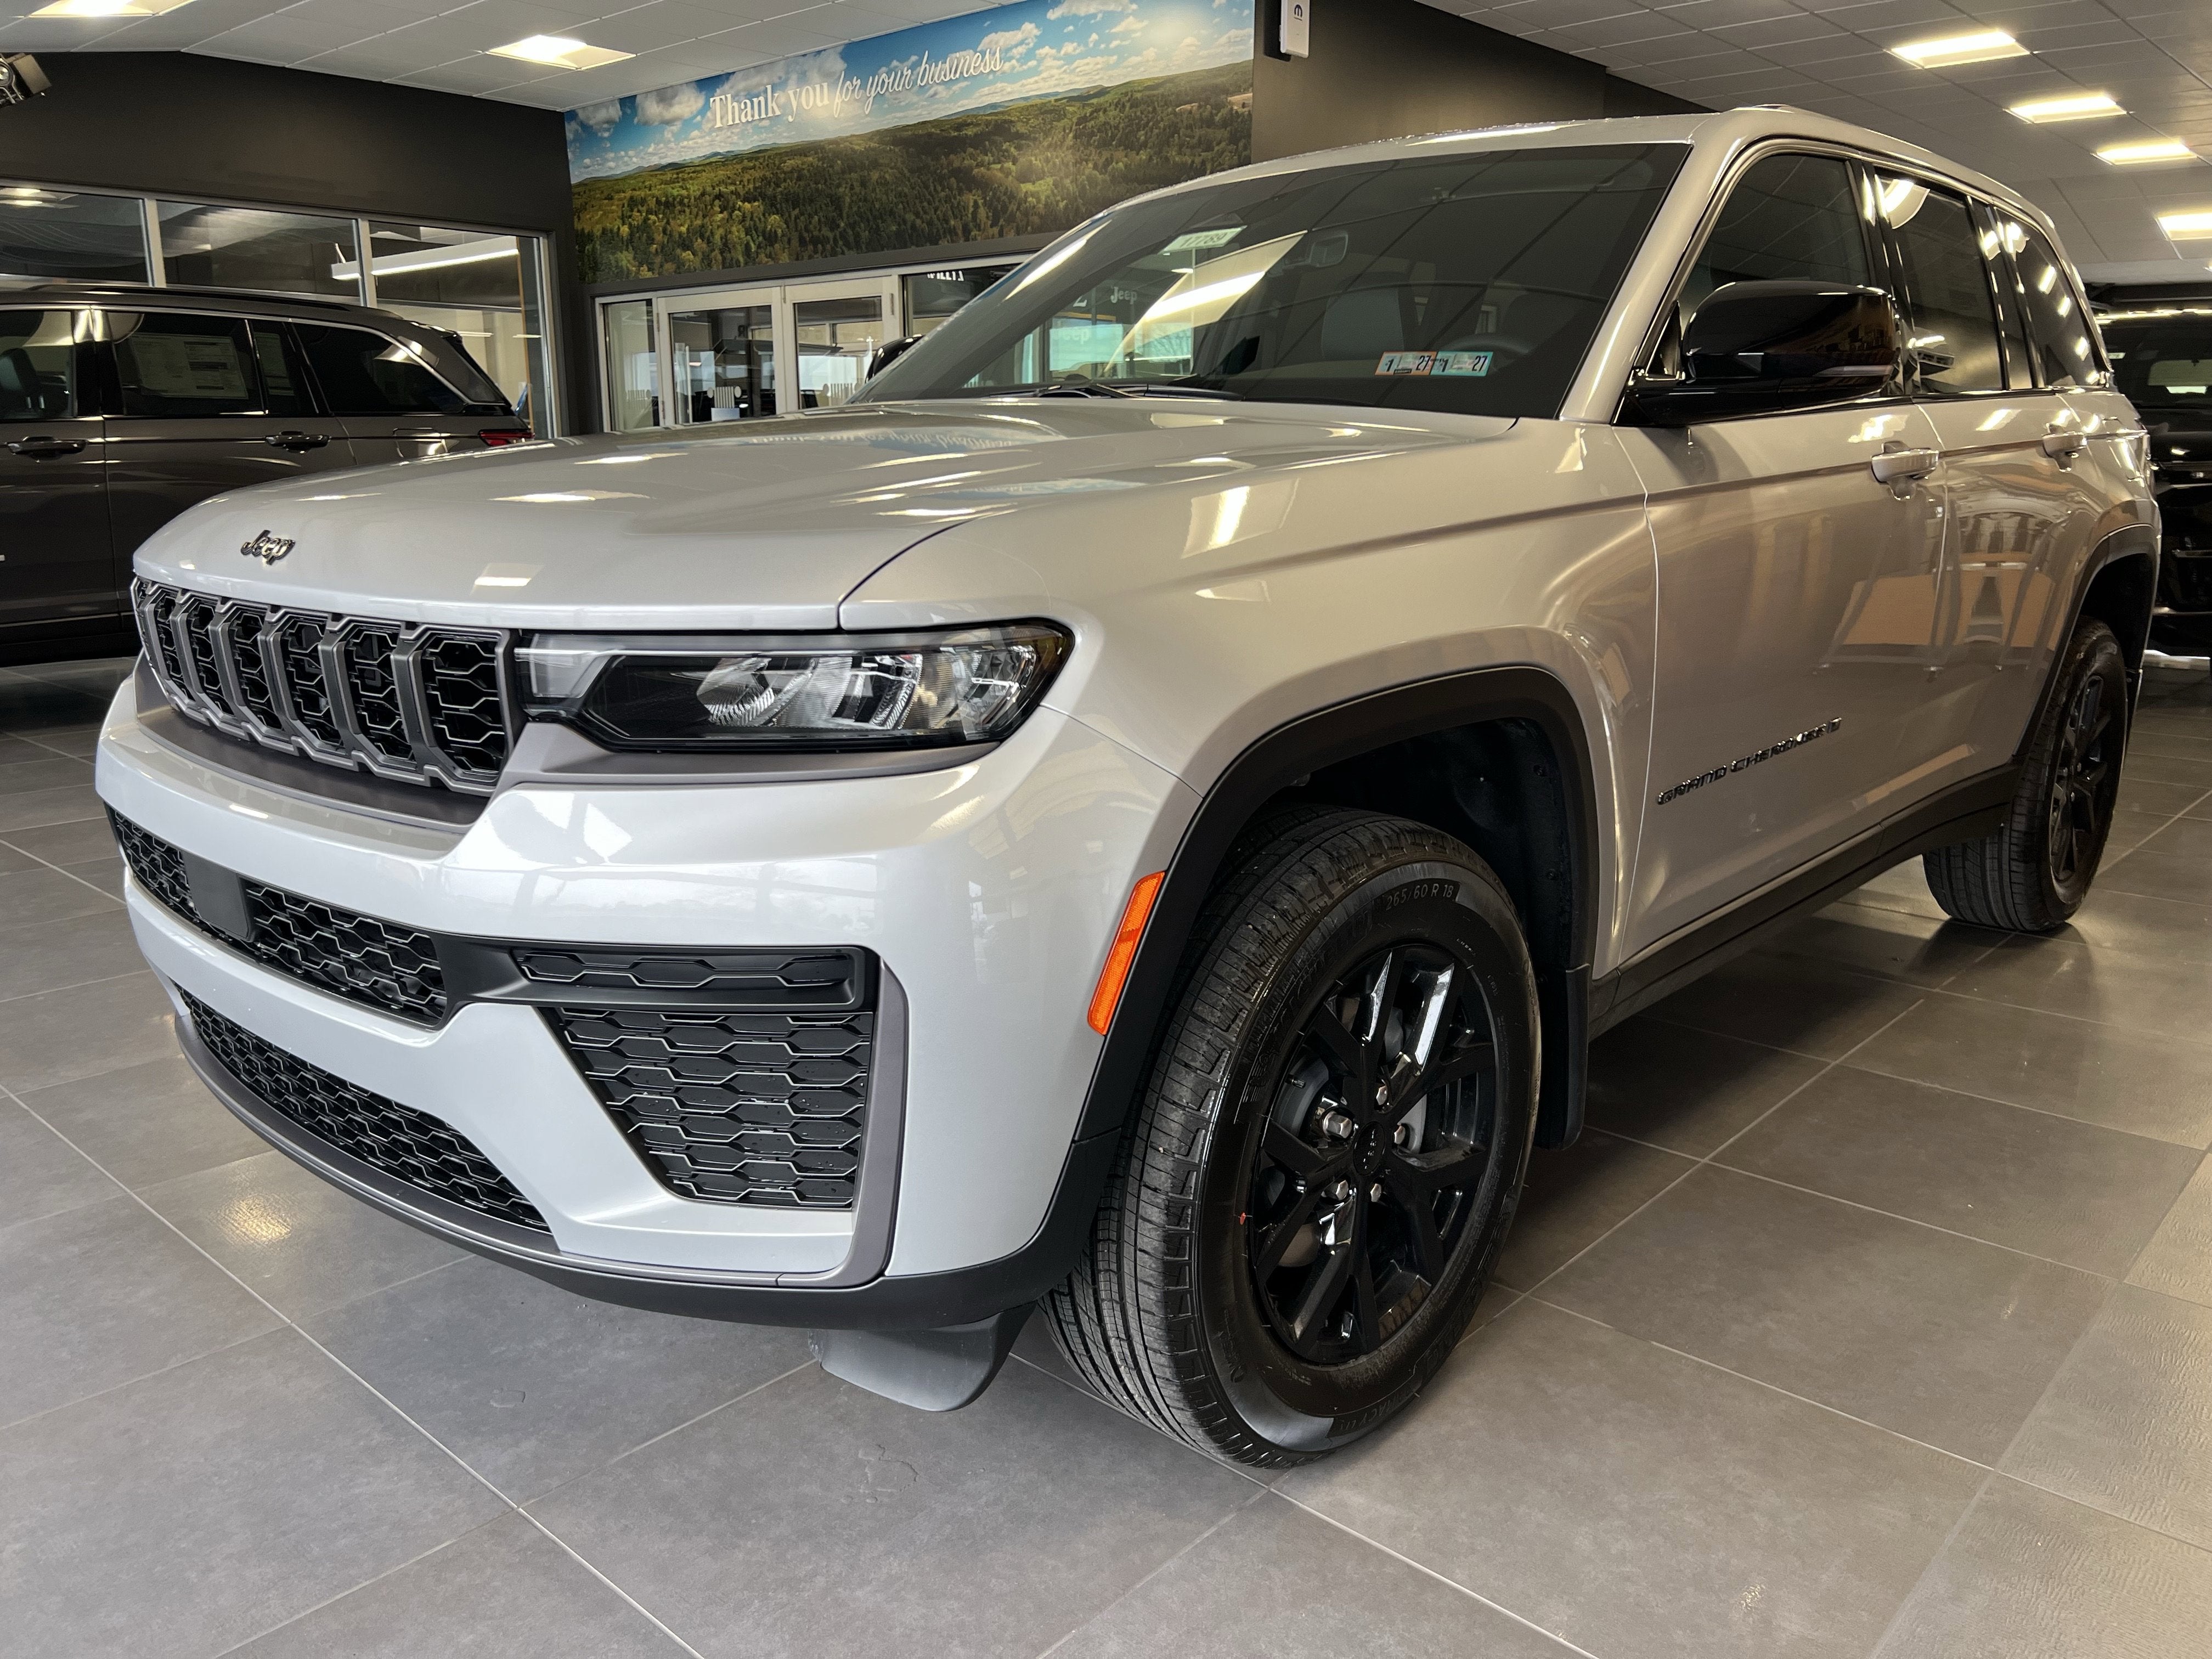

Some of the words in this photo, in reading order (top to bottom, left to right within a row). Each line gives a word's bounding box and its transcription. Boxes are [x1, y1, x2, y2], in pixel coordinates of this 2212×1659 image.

[710, 84, 782, 129] Thank
[787, 82, 830, 122] you
[833, 70, 865, 118] for
[864, 66, 914, 115] your
[917, 46, 1004, 87] business
[1110, 285, 1138, 304] Jeep
[1416, 355, 1432, 372] 27
[1471, 355, 1488, 372] 27
[240, 529, 296, 565] Jeep
[1657, 765, 1727, 805] GRAND
[1730, 723, 1826, 772] CHEROKEE
[1386, 884, 1428, 911] 265/60
[1431, 883, 1440, 897] R
[1443, 884, 1454, 898] 18
